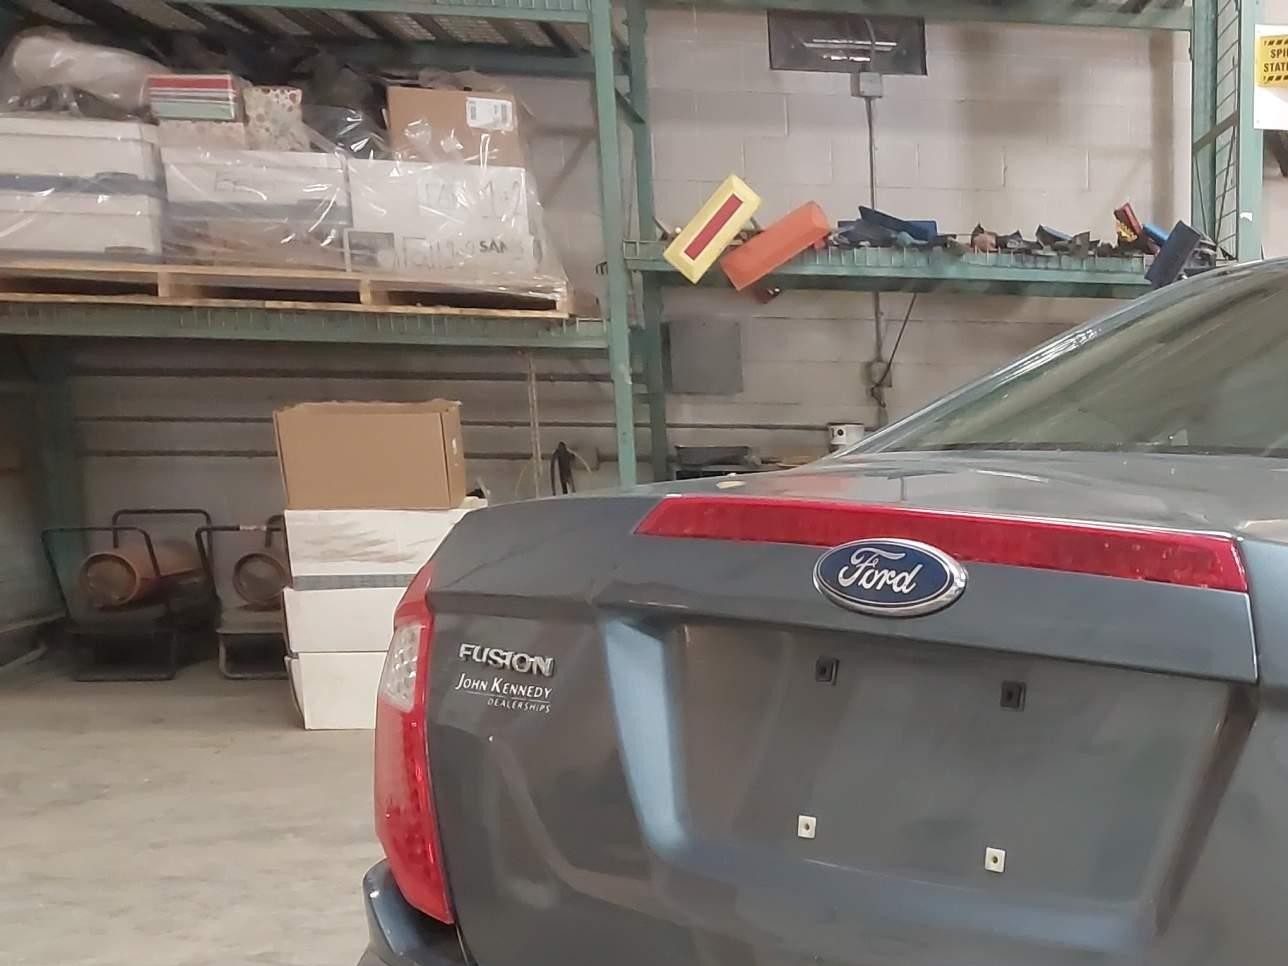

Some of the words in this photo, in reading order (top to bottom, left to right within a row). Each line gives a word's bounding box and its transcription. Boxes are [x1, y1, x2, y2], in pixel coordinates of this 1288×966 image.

[838, 547, 923, 594] Ford
[459, 643, 554, 677] FUSION
[455, 673, 489, 691] JOHN
[490, 677, 553, 699] KENNEDY
[487, 698, 552, 714] DEALERSHIPS
